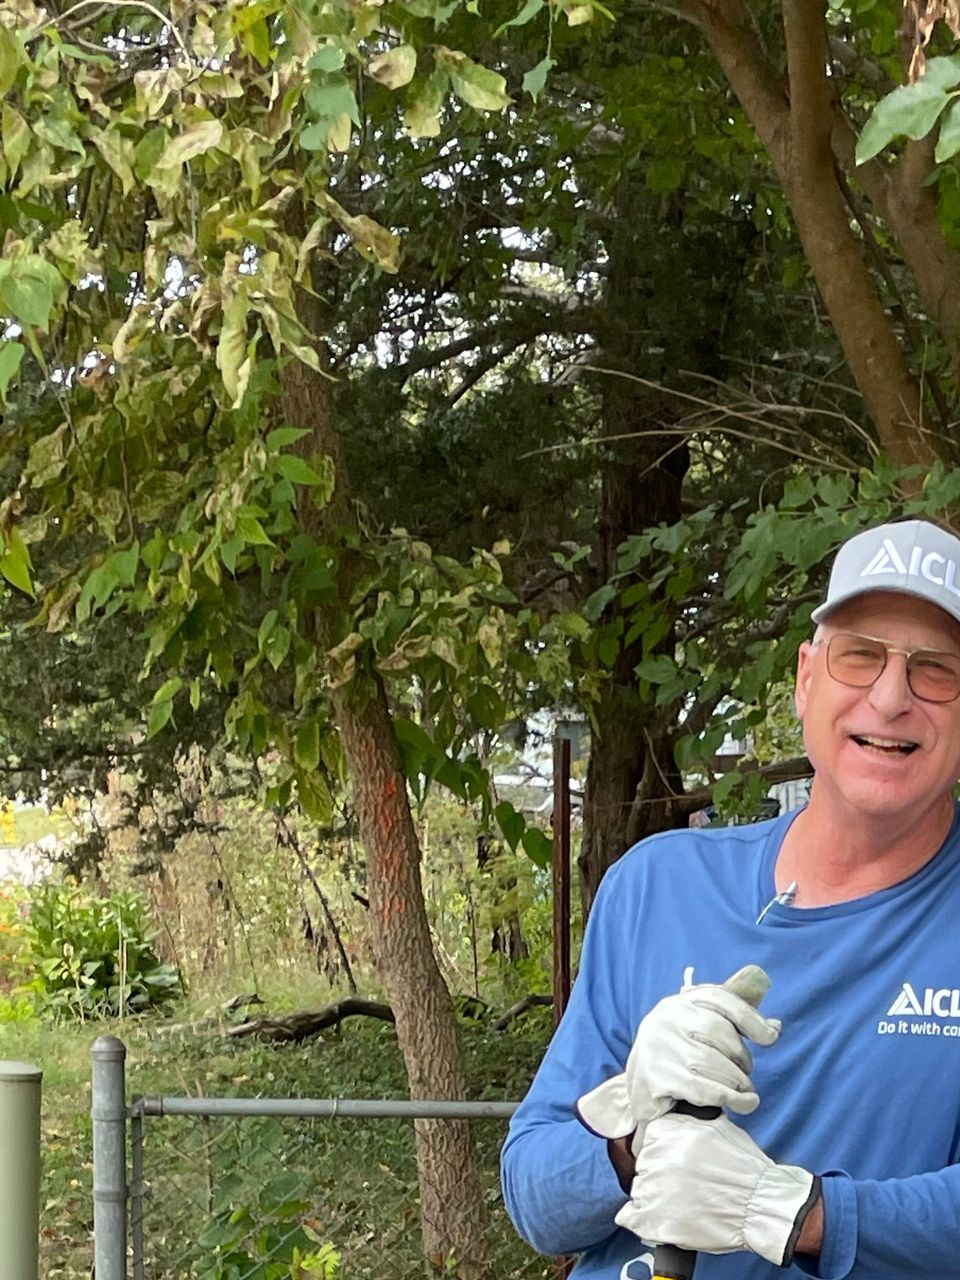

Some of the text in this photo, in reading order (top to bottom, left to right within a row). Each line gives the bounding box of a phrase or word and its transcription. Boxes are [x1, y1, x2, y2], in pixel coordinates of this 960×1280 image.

[878, 1021, 896, 1035] Do
[898, 1020, 909, 1034] it
[911, 1021, 941, 1036] with
